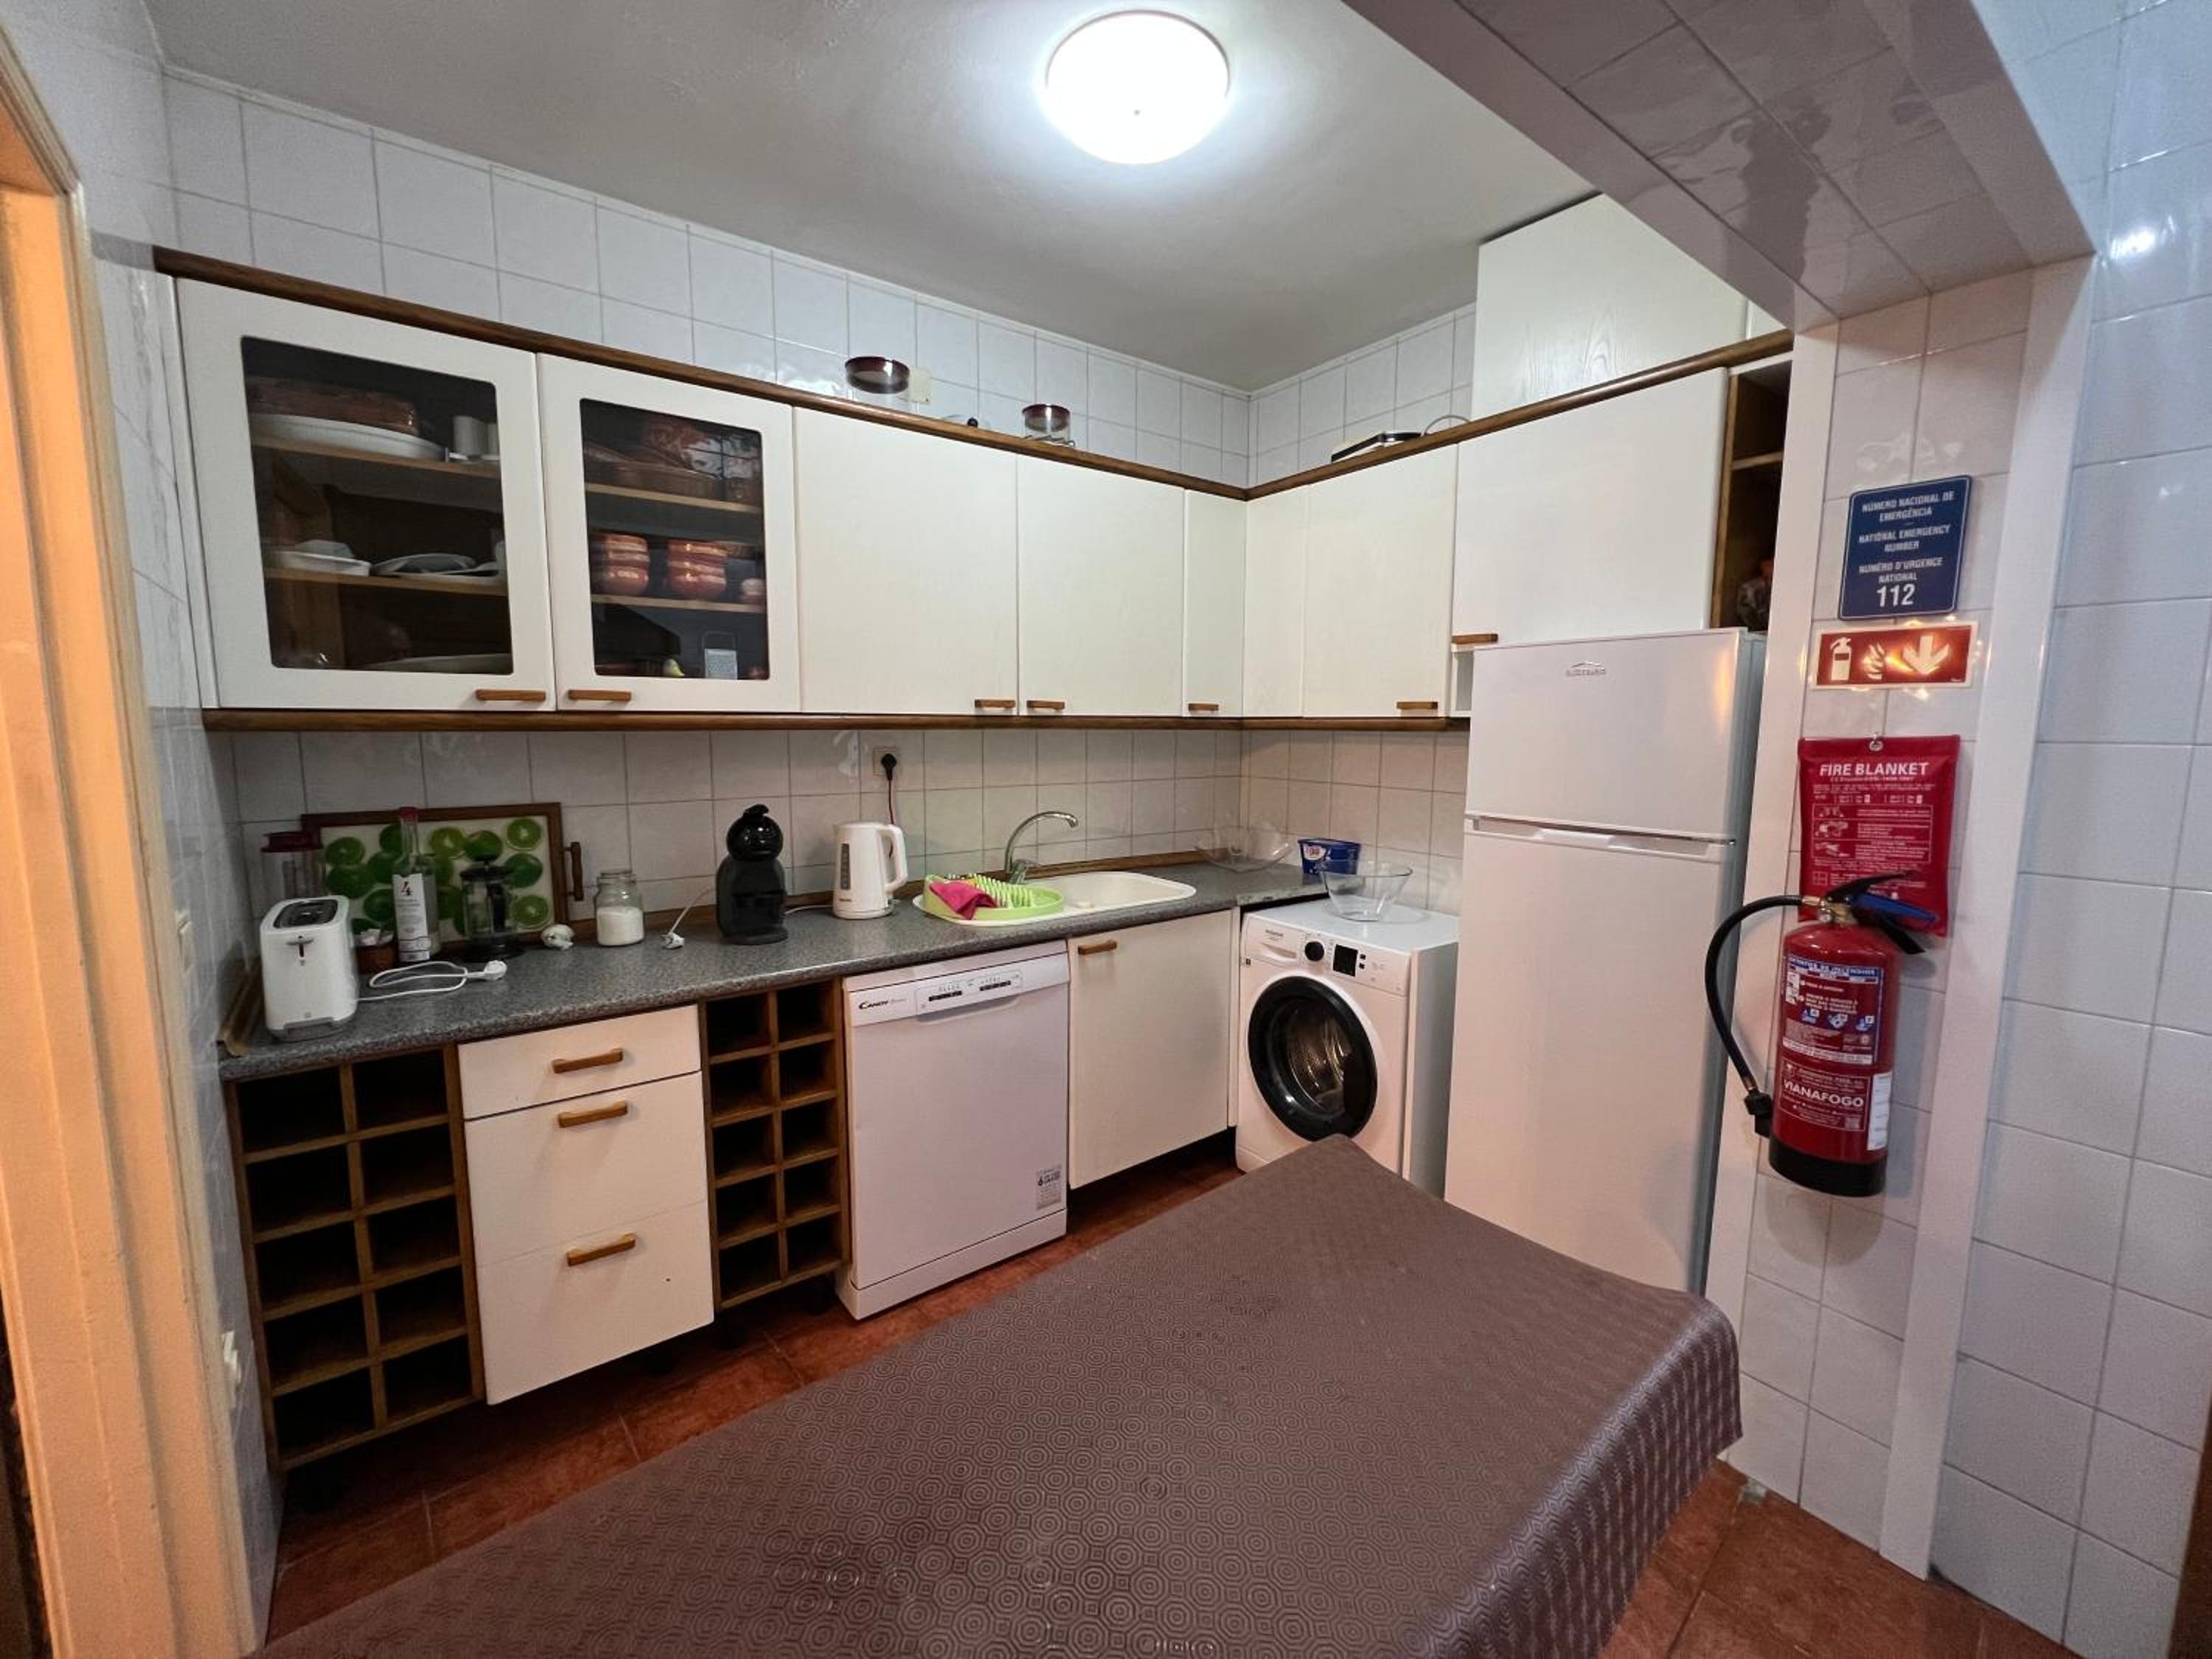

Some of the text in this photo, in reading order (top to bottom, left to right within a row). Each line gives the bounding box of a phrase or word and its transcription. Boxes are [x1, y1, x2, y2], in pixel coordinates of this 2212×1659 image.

[1899, 493, 1940, 507] NACIONAL
[1942, 491, 1955, 501] DE
[1879, 506, 1933, 522] EMERGÊNCIA
[1859, 524, 1950, 543] NATIONAL EMERGENCY
[1884, 540, 1920, 552] NUMBER
[1895, 557, 1944, 571] D'URGENCE
[1879, 572, 1917, 584] NATIONAL
[1877, 583, 1916, 608] 112
[1819, 762, 1929, 776] FIRE BLANKET
[1784, 1079, 1865, 1107] VIANAFOGO
